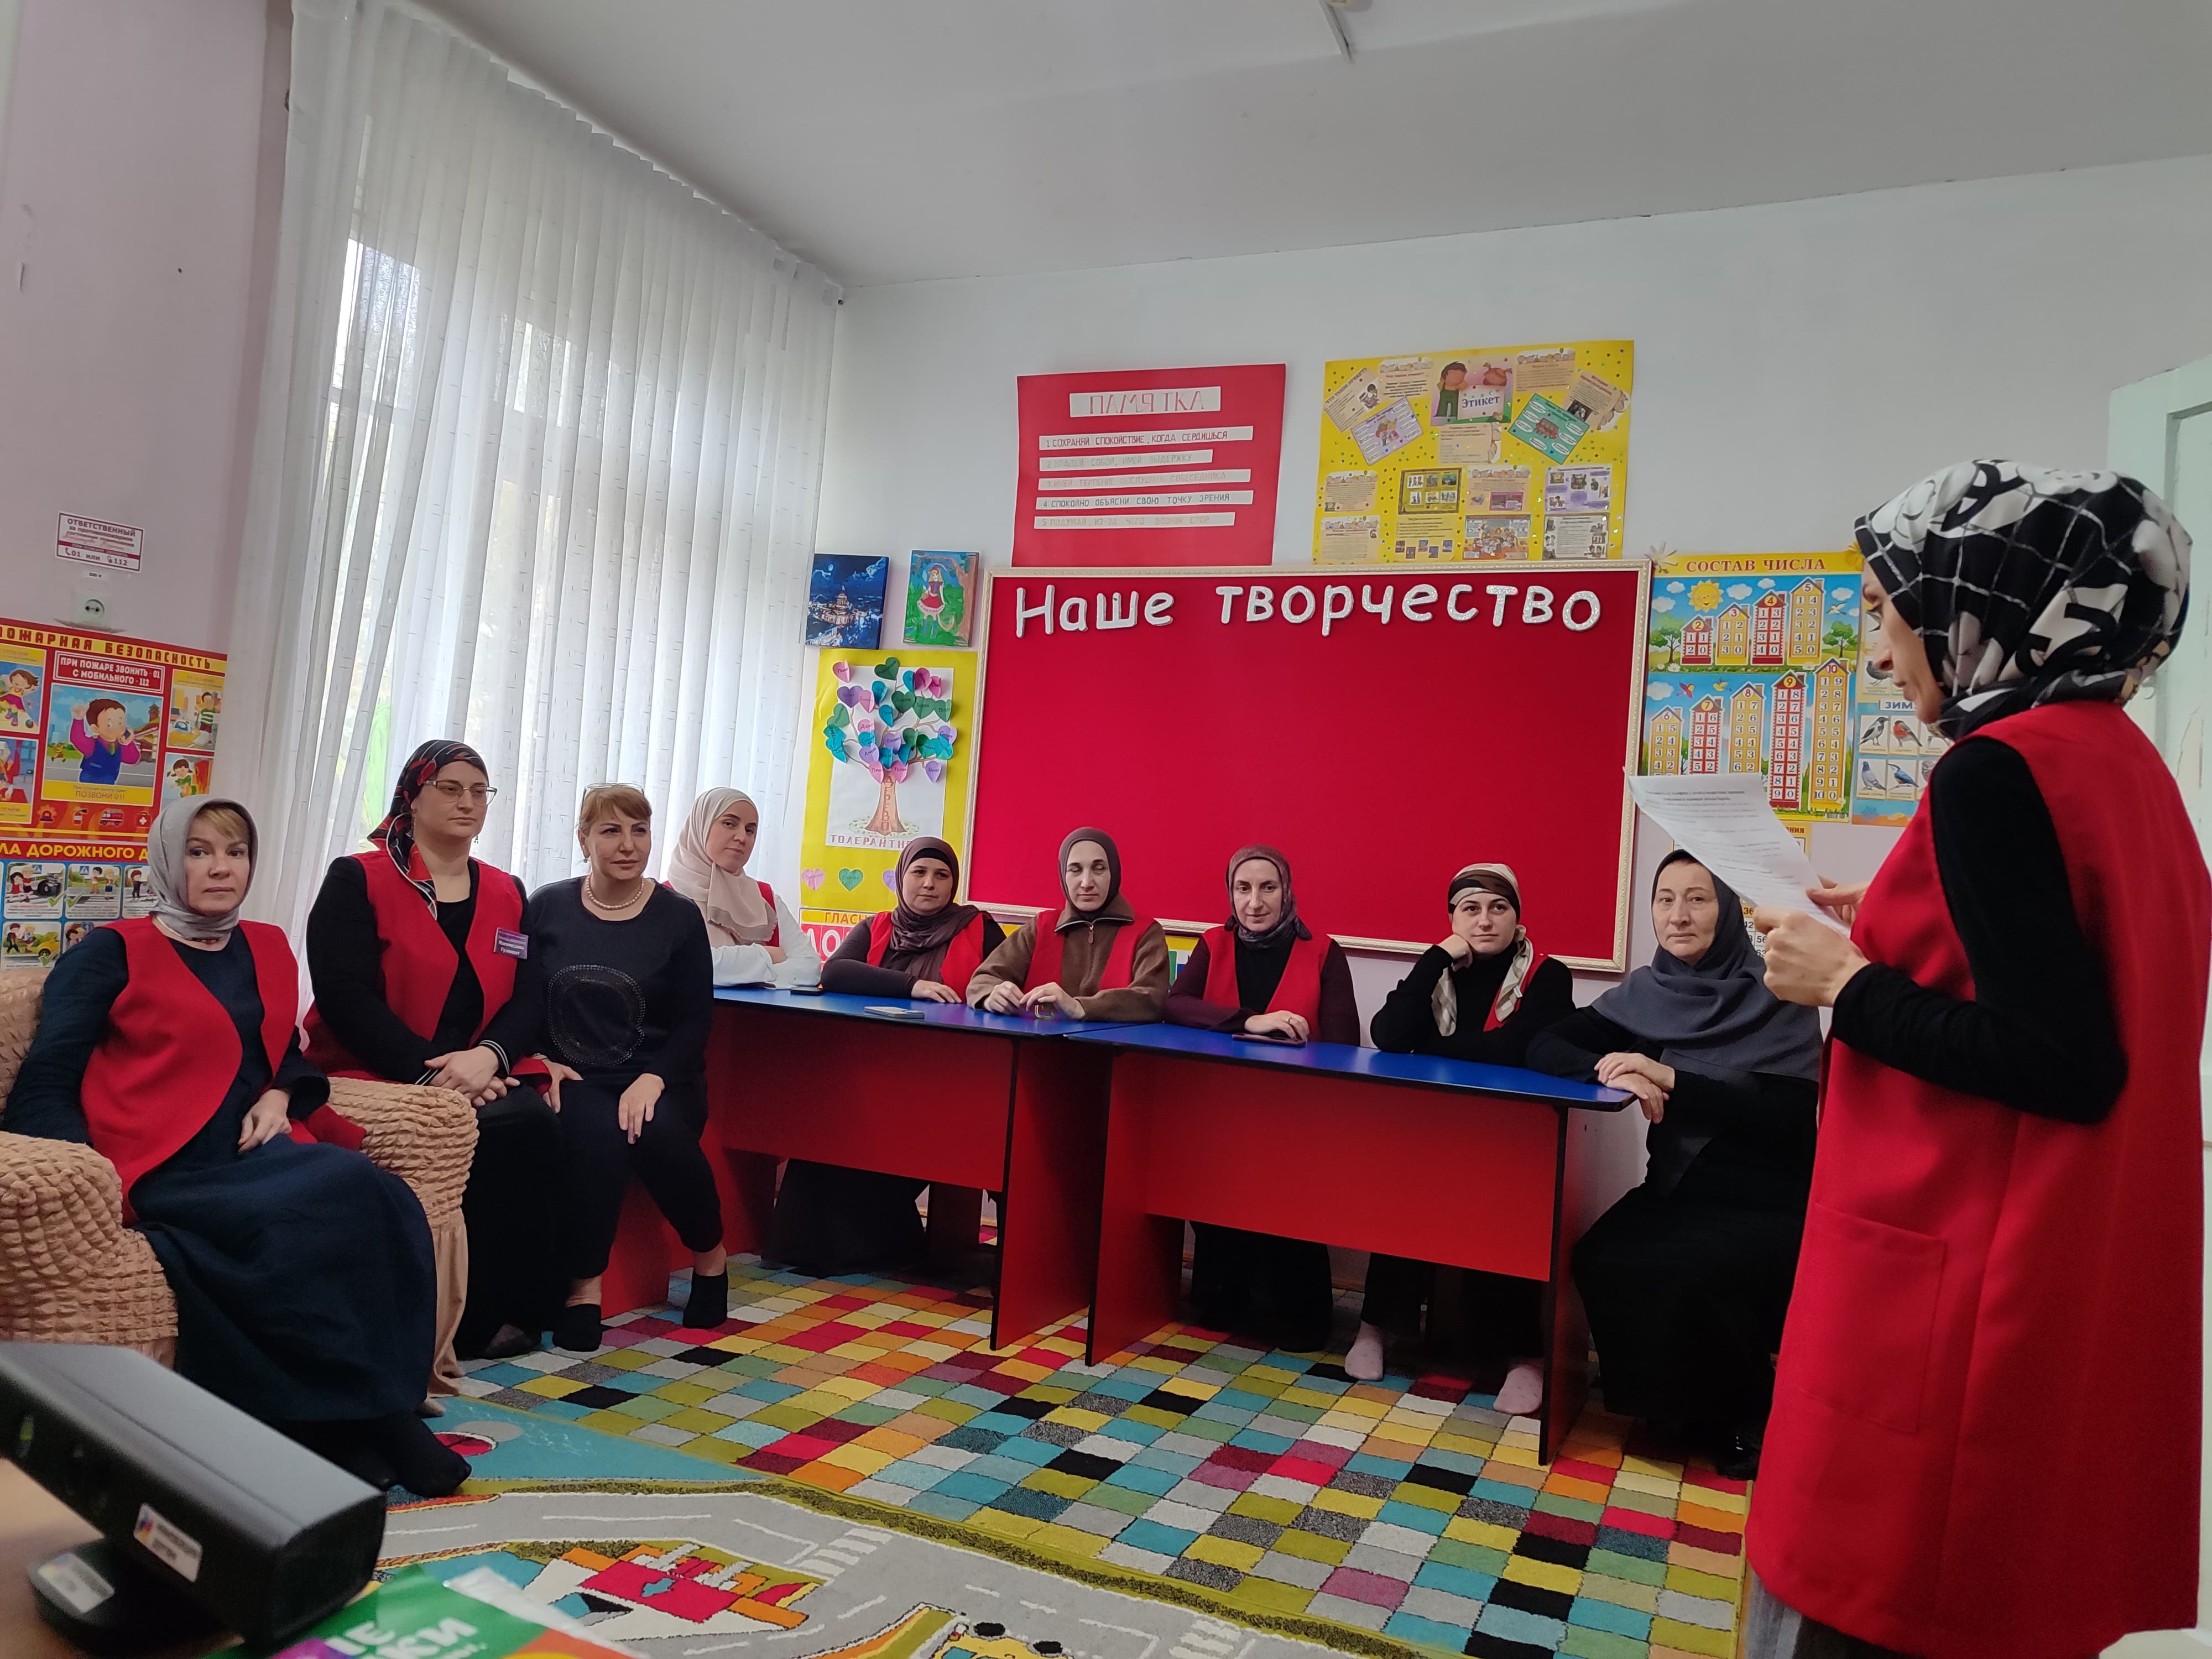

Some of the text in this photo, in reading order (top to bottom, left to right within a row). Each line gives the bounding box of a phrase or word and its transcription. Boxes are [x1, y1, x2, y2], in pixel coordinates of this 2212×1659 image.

[1089, 391, 1204, 414] ПАМЯТКА
[1462, 396, 1500, 408] Этикет
[1052, 437, 1090, 447] СОХРАНЯЙ
[1152, 434, 1176, 442] КОГДА
[1182, 431, 1228, 441] СЕРДИШЬСЯ
[1149, 454, 1192, 463] ВЫДЕРЖКУ
[1170, 472, 1226, 483] СОБЕСЕДНИКА
[1051, 499, 1089, 508] СПОКОЙНО
[1095, 497, 1129, 507] ОБЪЯСНИ
[1167, 495, 1192, 504] ТОЧКУ
[1199, 493, 1230, 502] ЗРЕНИЯ
[1190, 515, 1210, 524] СПОР
[67, 518, 135, 537] ОТВЕТСТВЕННЫЙ
[1686, 559, 1825, 572] СОСТАВ ЧИСЛА
[1016, 583, 1603, 637] Наше творчество
[1731, 609, 1737, 617] 3
[1695, 621, 1701, 629] 2
[0, 627, 210, 669] ОЖАРНАЯ БЕЗОПАСНОСТЬ
[1735, 646, 1741, 654] 0
[1808, 646, 1814, 654] 0
[60, 657, 160, 679] ПРИ ПОЖАРЕ ЗВОНИТЬ 01
[1827, 665, 1838, 673] 10
[81, 670, 134, 685] МОБИЛЬНОГО
[139, 679, 149, 687] 112
[1787, 678, 1793, 686] 9
[1835, 677, 1841, 686] 9
[1745, 689, 1751, 697] 8
[1834, 690, 1841, 698] 8
[1705, 701, 1710, 709] 7
[1751, 701, 1757, 709] 7
[1834, 702, 1840, 711] 7
[1833, 716, 1840, 724] 6
[1669, 724, 1676, 733] 5
[1736, 726, 1756, 734] 3 5
[1832, 728, 1839, 736] 5
[1668, 737, 1675, 745] 4
[1655, 748, 1674, 757] 3 3
[75, 791, 112, 800] ПОЗВОНИ
[1814, 791, 1836, 800] 10 0
[27, 844, 135, 859] ДОРОЖНОГО
